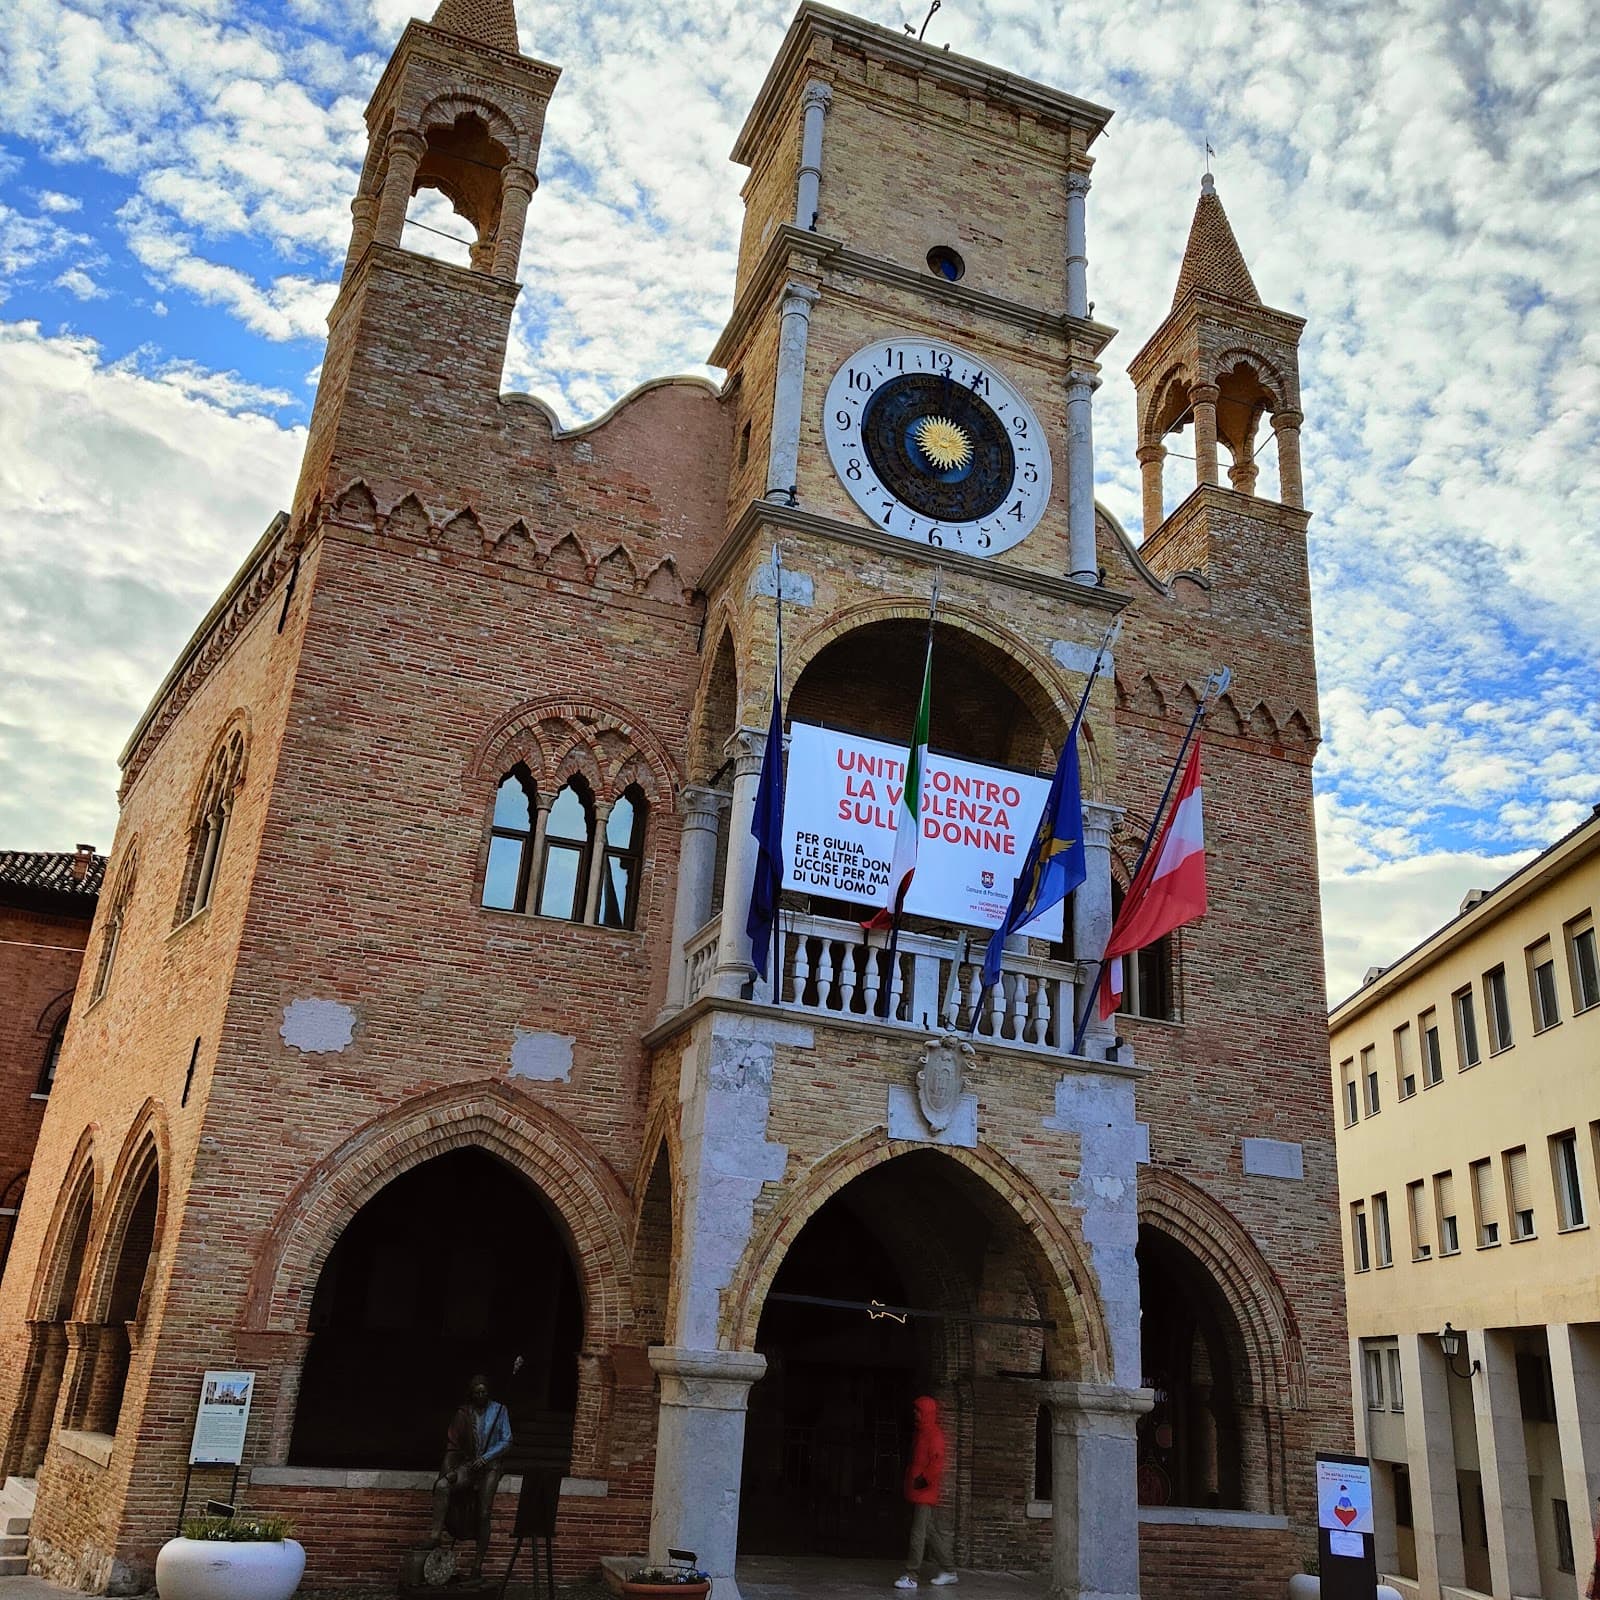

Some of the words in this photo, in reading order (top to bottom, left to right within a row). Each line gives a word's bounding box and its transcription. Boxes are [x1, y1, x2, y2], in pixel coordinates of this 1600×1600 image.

[885, 347, 904, 370] 11
[930, 350, 953, 373] 12
[848, 368, 872, 392] 10
[984, 377, 990, 396] 1
[836, 410, 851, 431] 9
[1013, 416, 1028, 439] 2
[846, 458, 862, 481] 8
[1024, 462, 1038, 483] 3
[881, 501, 895, 525] 7
[1007, 500, 1026, 522] 4
[928, 527, 943, 547] 6
[977, 527, 991, 549] 5
[837, 748, 905, 783] UNITI
[846, 775, 876, 801] LA
[886, 784, 1010, 830] VLENZA
[838, 799, 898, 831] SULL
[924, 818, 1016, 855] DONNE
[796, 831, 820, 845] PER
[823, 837, 865, 856] GIULIA
[795, 844, 802, 855] E
[806, 846, 819, 859] LE
[822, 850, 858, 867] ALTRE
[862, 858, 892, 874] DON
[793, 869, 806, 882] DI
[810, 873, 830, 887] UN
[834, 877, 877, 896] UOMO
[794, 857, 839, 875] UCCISE
[842, 866, 866, 881] PER
[869, 872, 890, 886] MA
